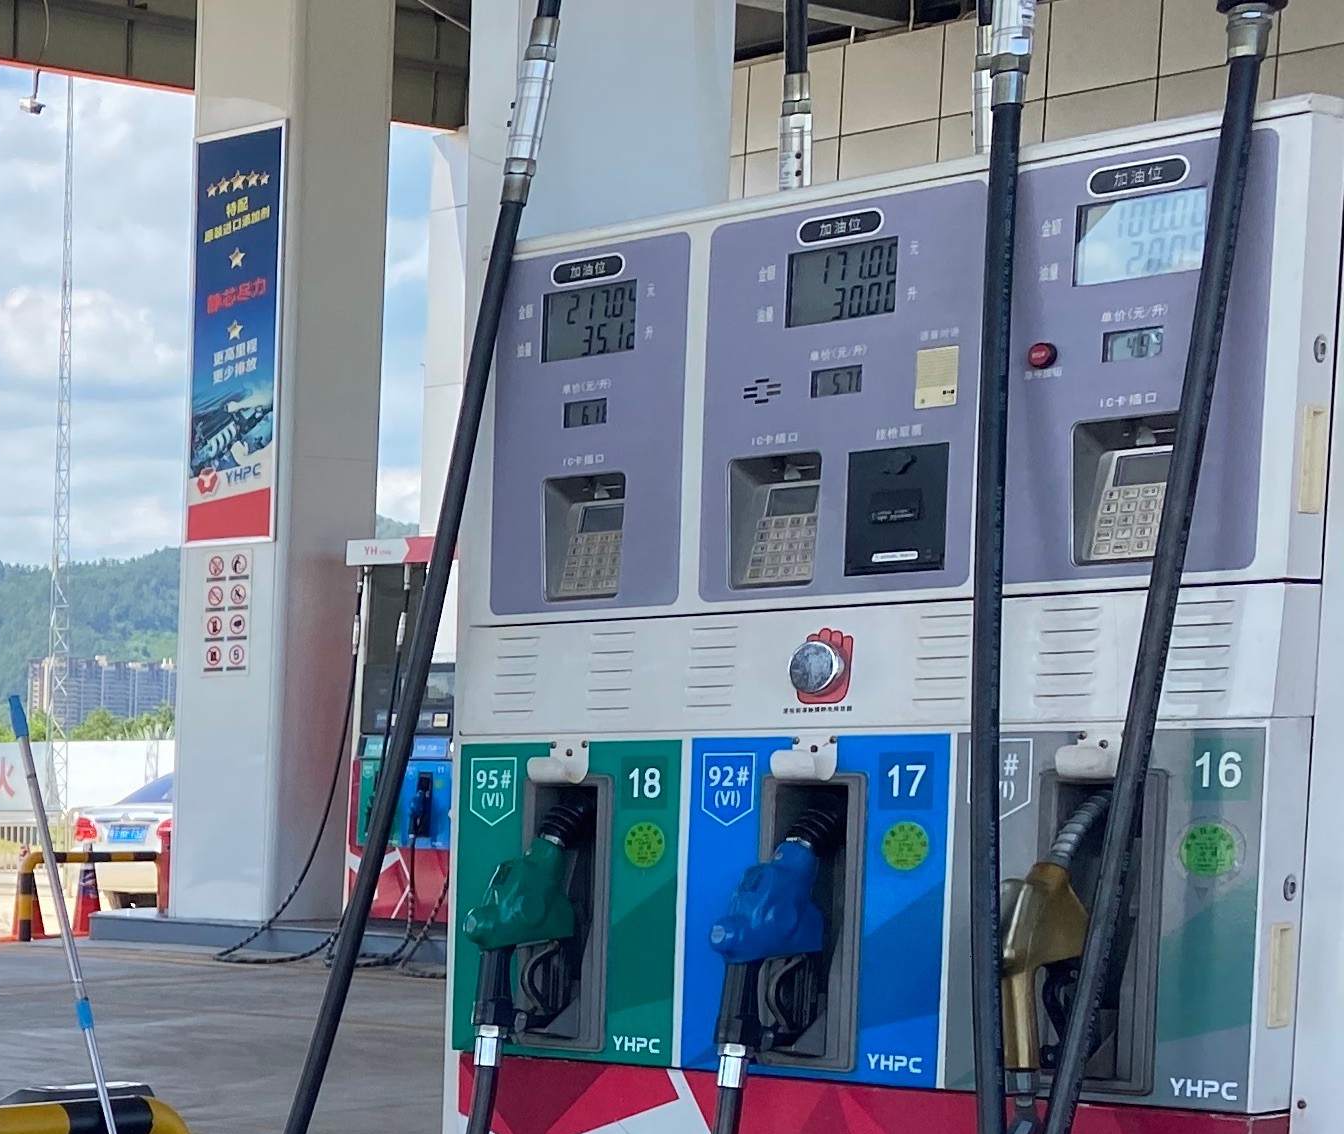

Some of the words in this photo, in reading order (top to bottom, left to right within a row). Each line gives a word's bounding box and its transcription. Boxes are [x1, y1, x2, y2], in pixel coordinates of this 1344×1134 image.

[1114, 166, 1163, 187] 加油位
[819, 217, 862, 237] 加油位
[570, 261, 606, 279] 加油位
[225, 462, 262, 485] YHPC
[475, 769, 512, 790] 95#
[708, 765, 750, 787] 92#
[1195, 750, 1243, 788] 16
[628, 767, 662, 799] 18
[888, 764, 928, 797] 17
[481, 791, 505, 809] (VI)
[714, 790, 742, 809] (VI)
[612, 1035, 662, 1054] YHPC
[866, 1052, 923, 1074] YHPC
[1169, 1077, 1240, 1101] YHPC
